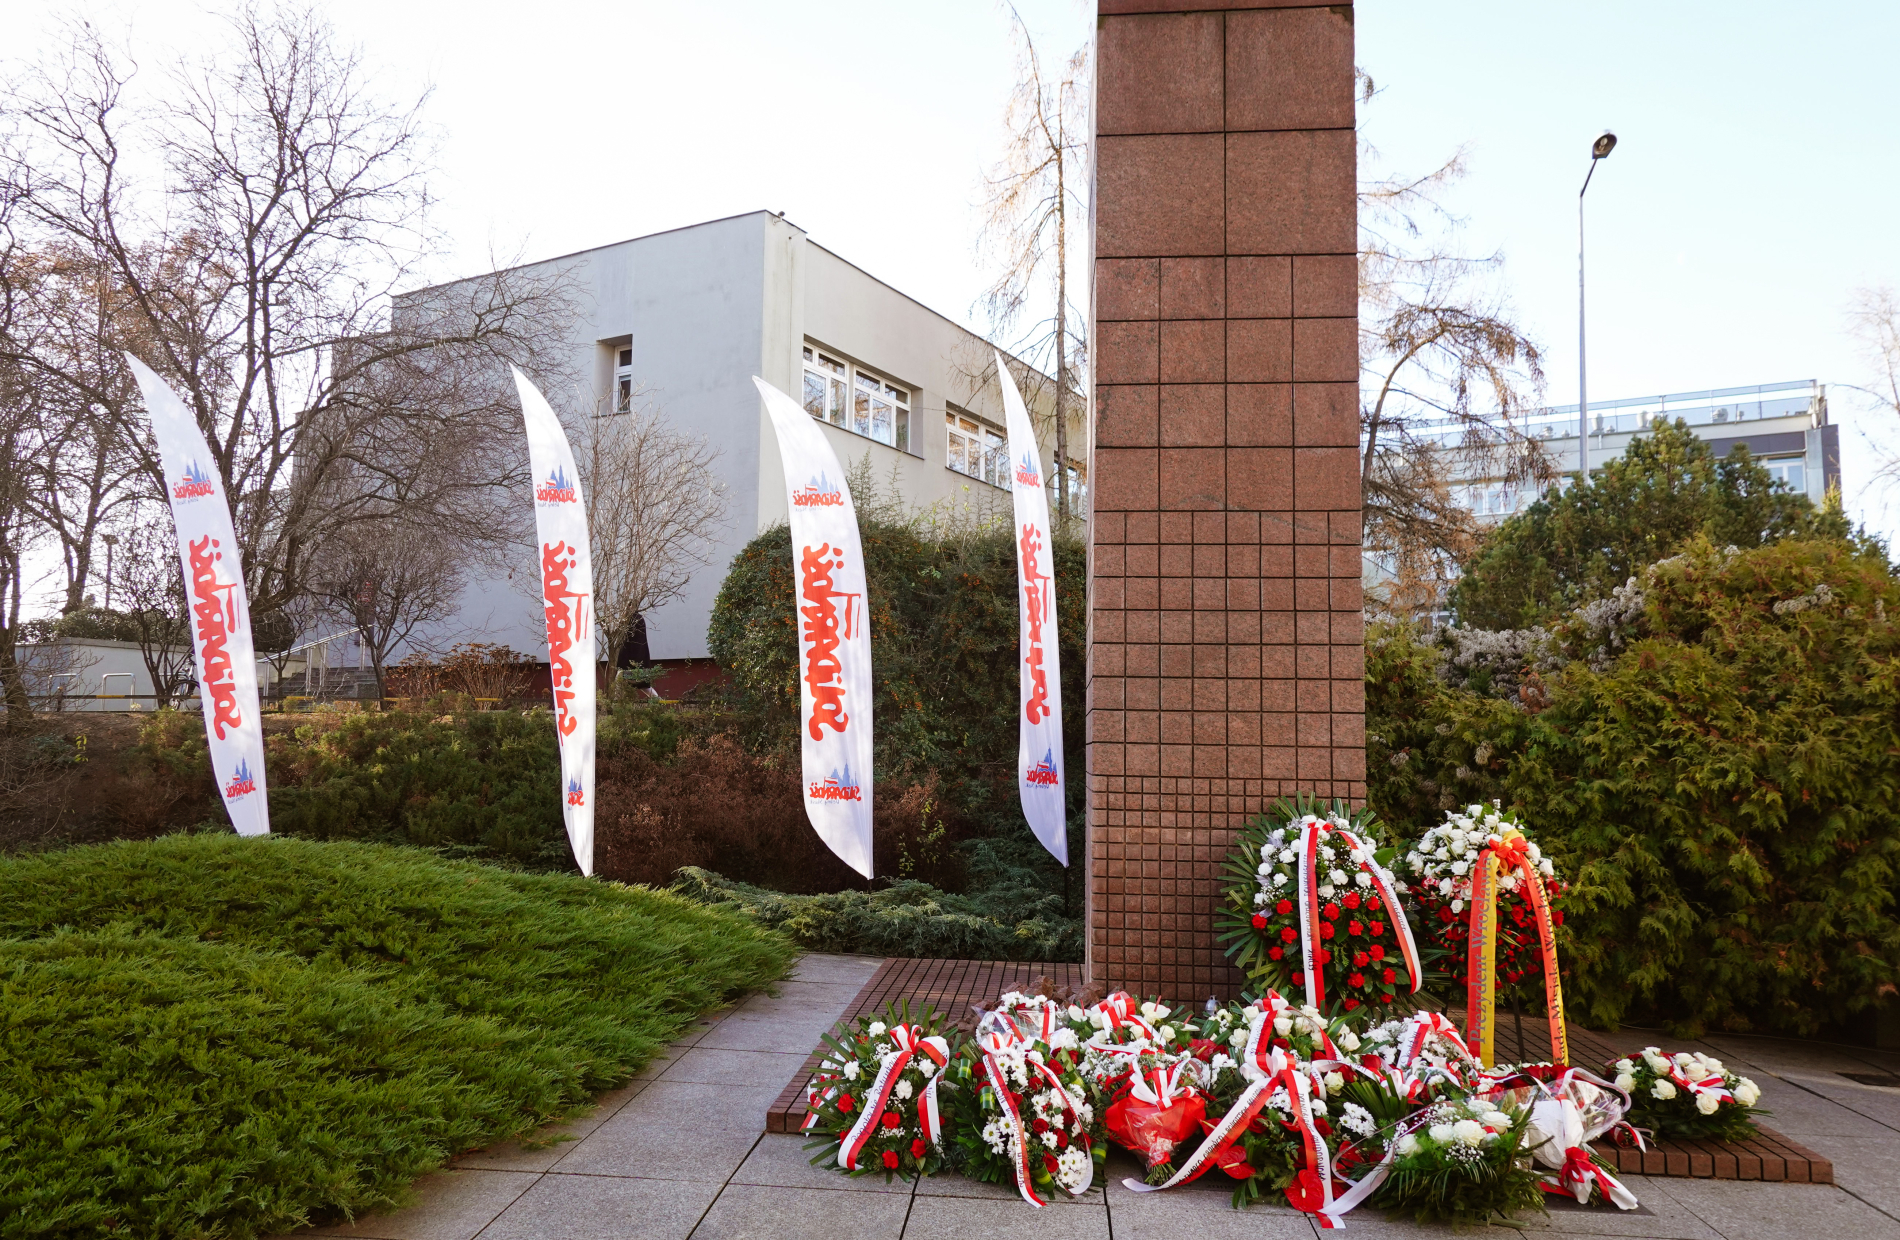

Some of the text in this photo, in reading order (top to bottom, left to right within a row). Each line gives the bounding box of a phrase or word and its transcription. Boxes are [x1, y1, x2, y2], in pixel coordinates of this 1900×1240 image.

[1469, 856, 1493, 1044] Prezydent Wrocławia
[1548, 956, 1564, 1020] Miejska
[1553, 1024, 1565, 1066] Rada
